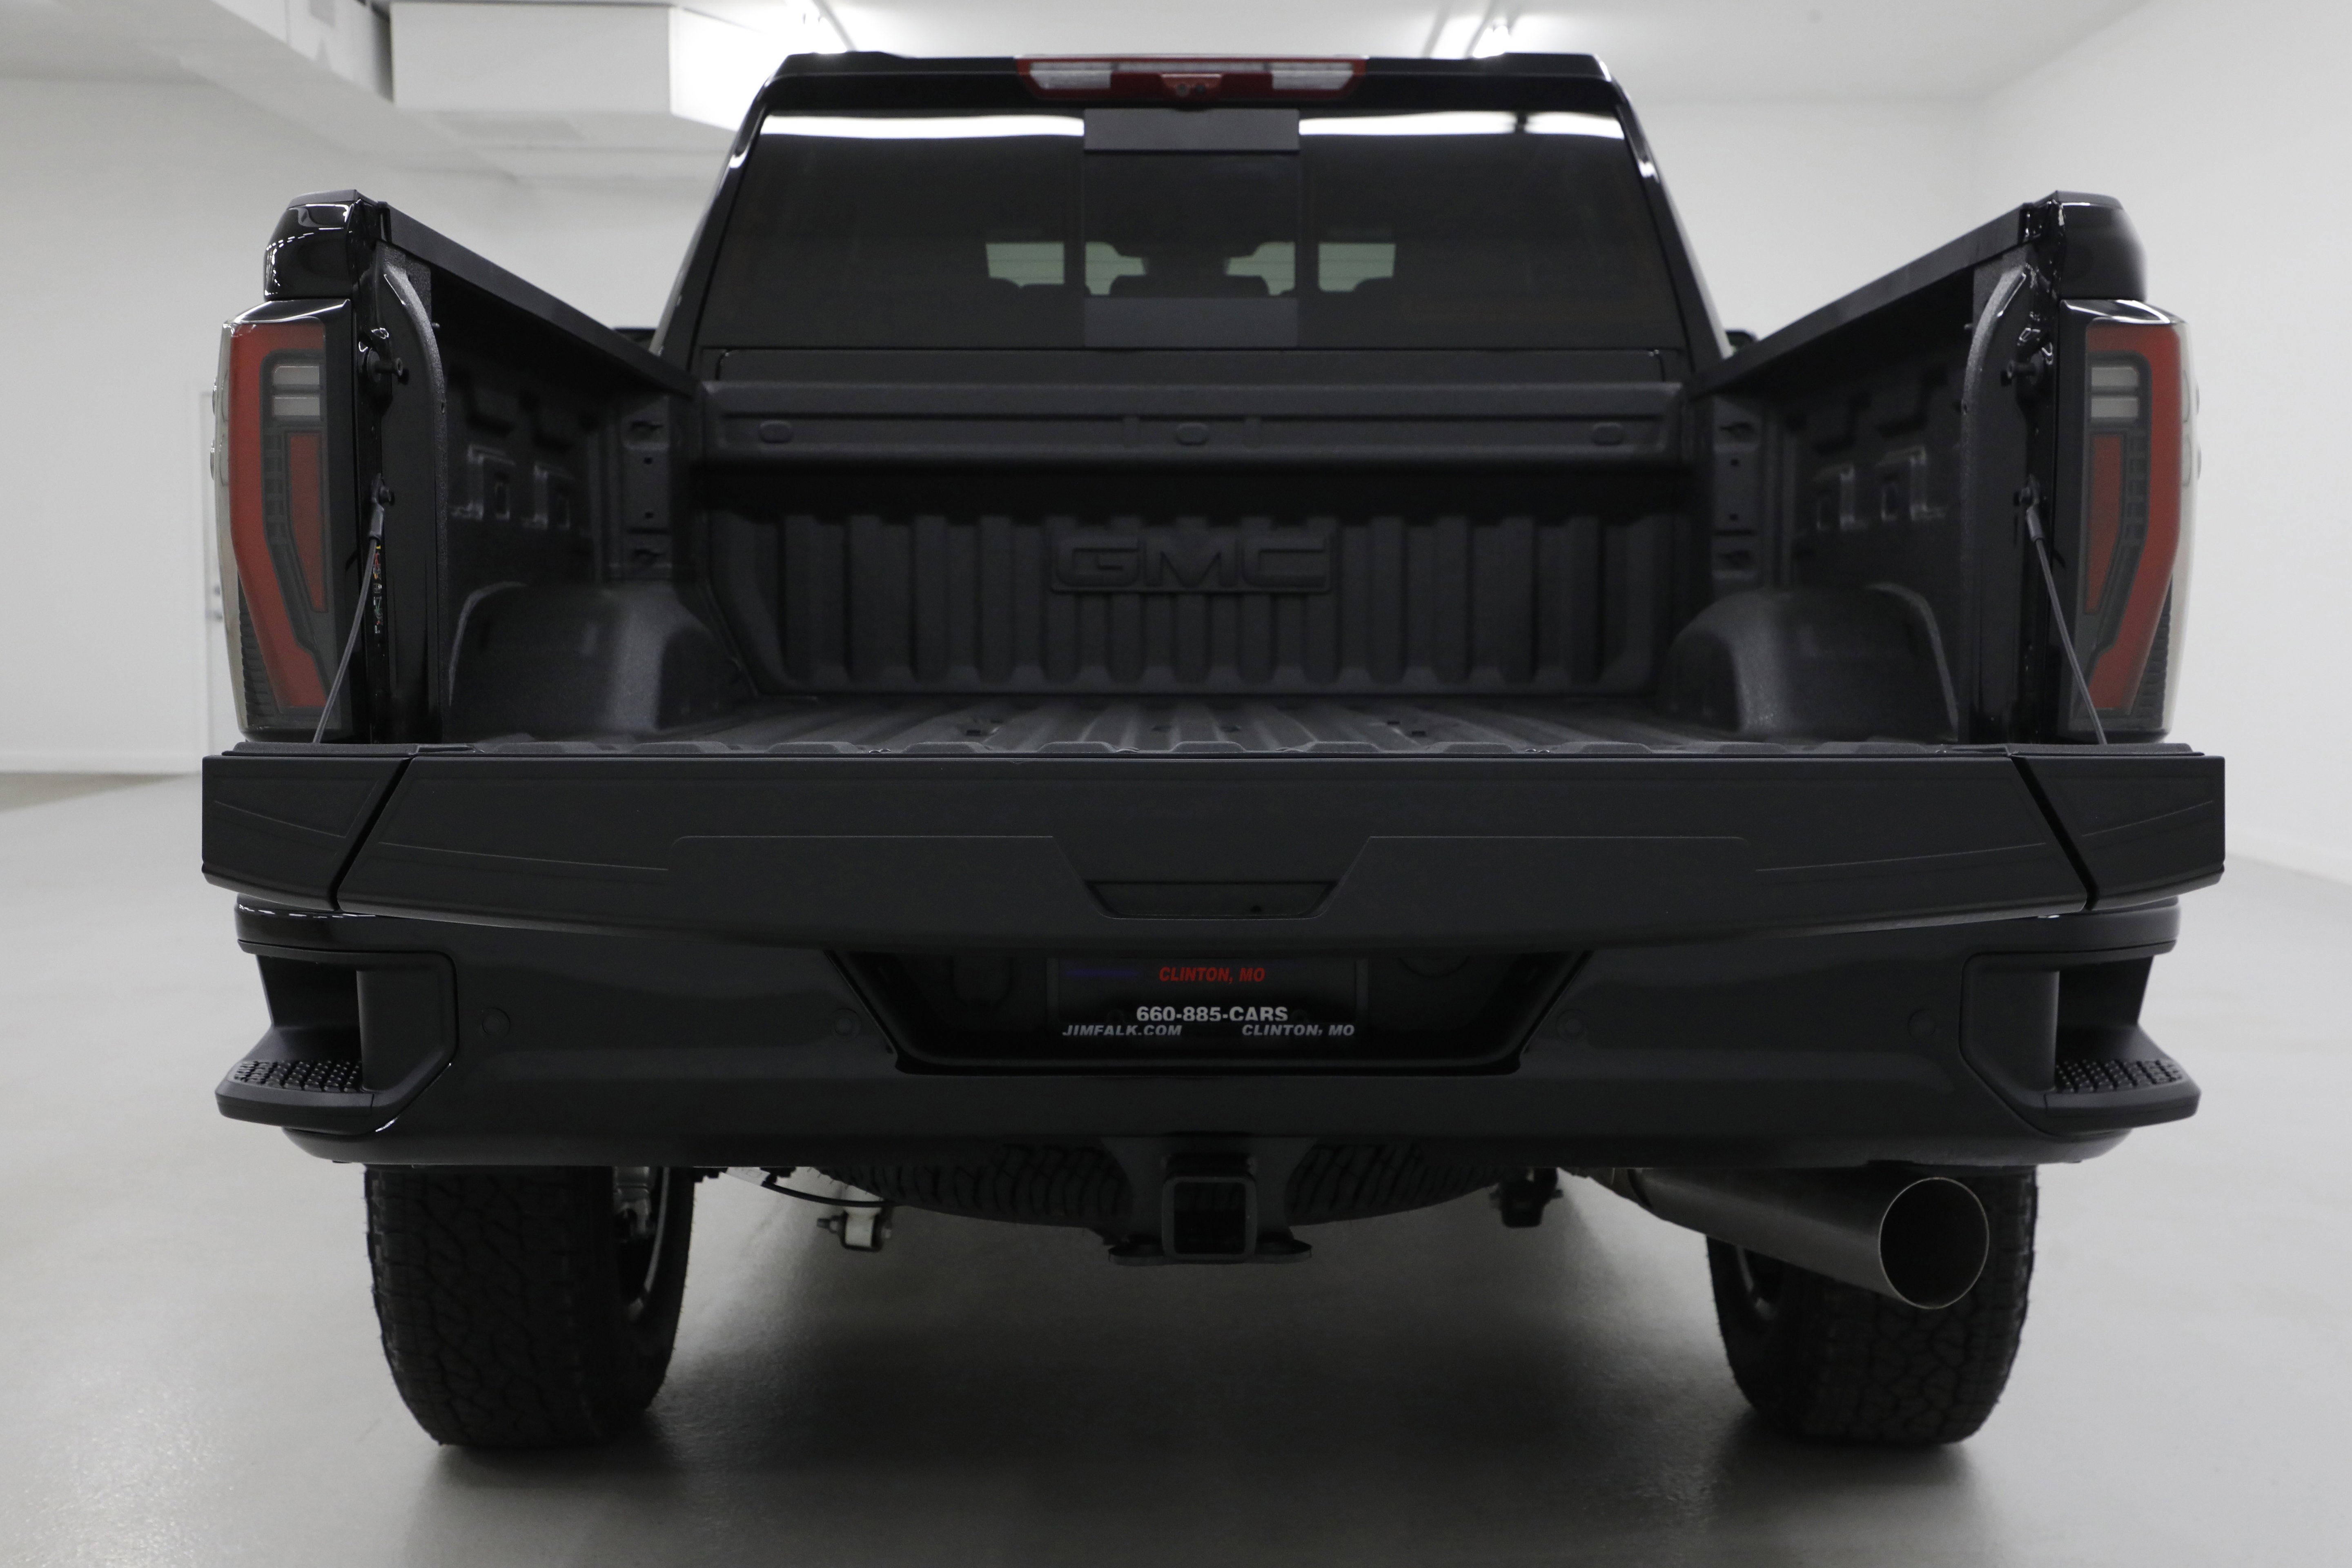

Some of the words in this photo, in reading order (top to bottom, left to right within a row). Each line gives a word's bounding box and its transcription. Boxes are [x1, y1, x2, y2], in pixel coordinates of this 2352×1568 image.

[1056, 536, 1327, 587] GMC
[1159, 967, 1234, 984] CLINTON,
[1239, 967, 1265, 982] MO
[1136, 1006, 1288, 1022] 660-885-CARS
[1062, 1025, 1183, 1036] JIMFALK.COM
[1241, 1024, 1323, 1036] CLINTON,
[1328, 1024, 1355, 1036] MO
